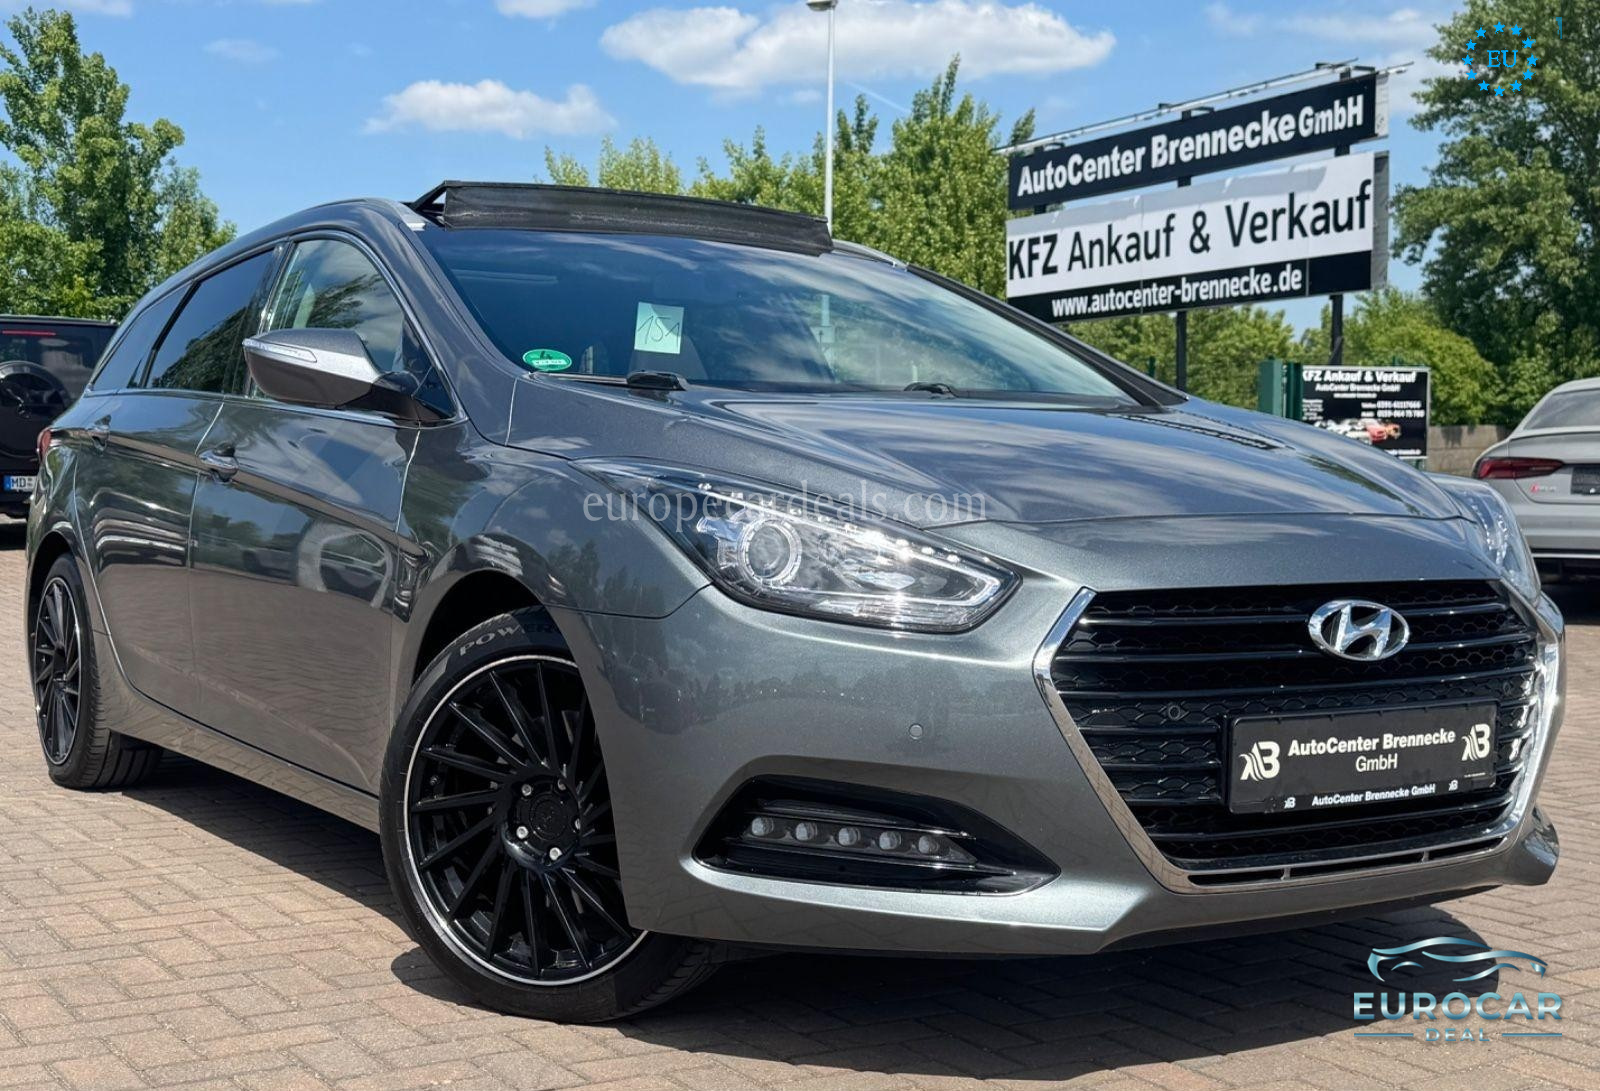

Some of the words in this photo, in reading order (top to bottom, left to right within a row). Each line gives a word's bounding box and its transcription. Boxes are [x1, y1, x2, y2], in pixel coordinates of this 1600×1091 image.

[1017, 146, 1146, 197] AutoCenter
[1150, 109, 1296, 169] Brennecke
[1298, 94, 1364, 138] GmbH
[1008, 233, 1058, 280] KFZ
[1067, 213, 1175, 272] Ankauf
[1189, 210, 1211, 254] &
[1225, 179, 1372, 248] Verkauf
[1052, 263, 1302, 317] www.autocenter-brennecke.de
[1323, 370, 1362, 382] Ankauf
[1364, 371, 1374, 382] &
[1375, 371, 1416, 383] Verkauf
[11, 478, 27, 488] MD
[1288, 736, 1379, 757] AutoCenter
[1383, 728, 1456, 749] Brennecke
[1355, 753, 1398, 773] GmbH
[1312, 792, 1362, 806] AutoCenter
[1365, 787, 1409, 801] Brennecke
[1411, 784, 1436, 795] GmbH
